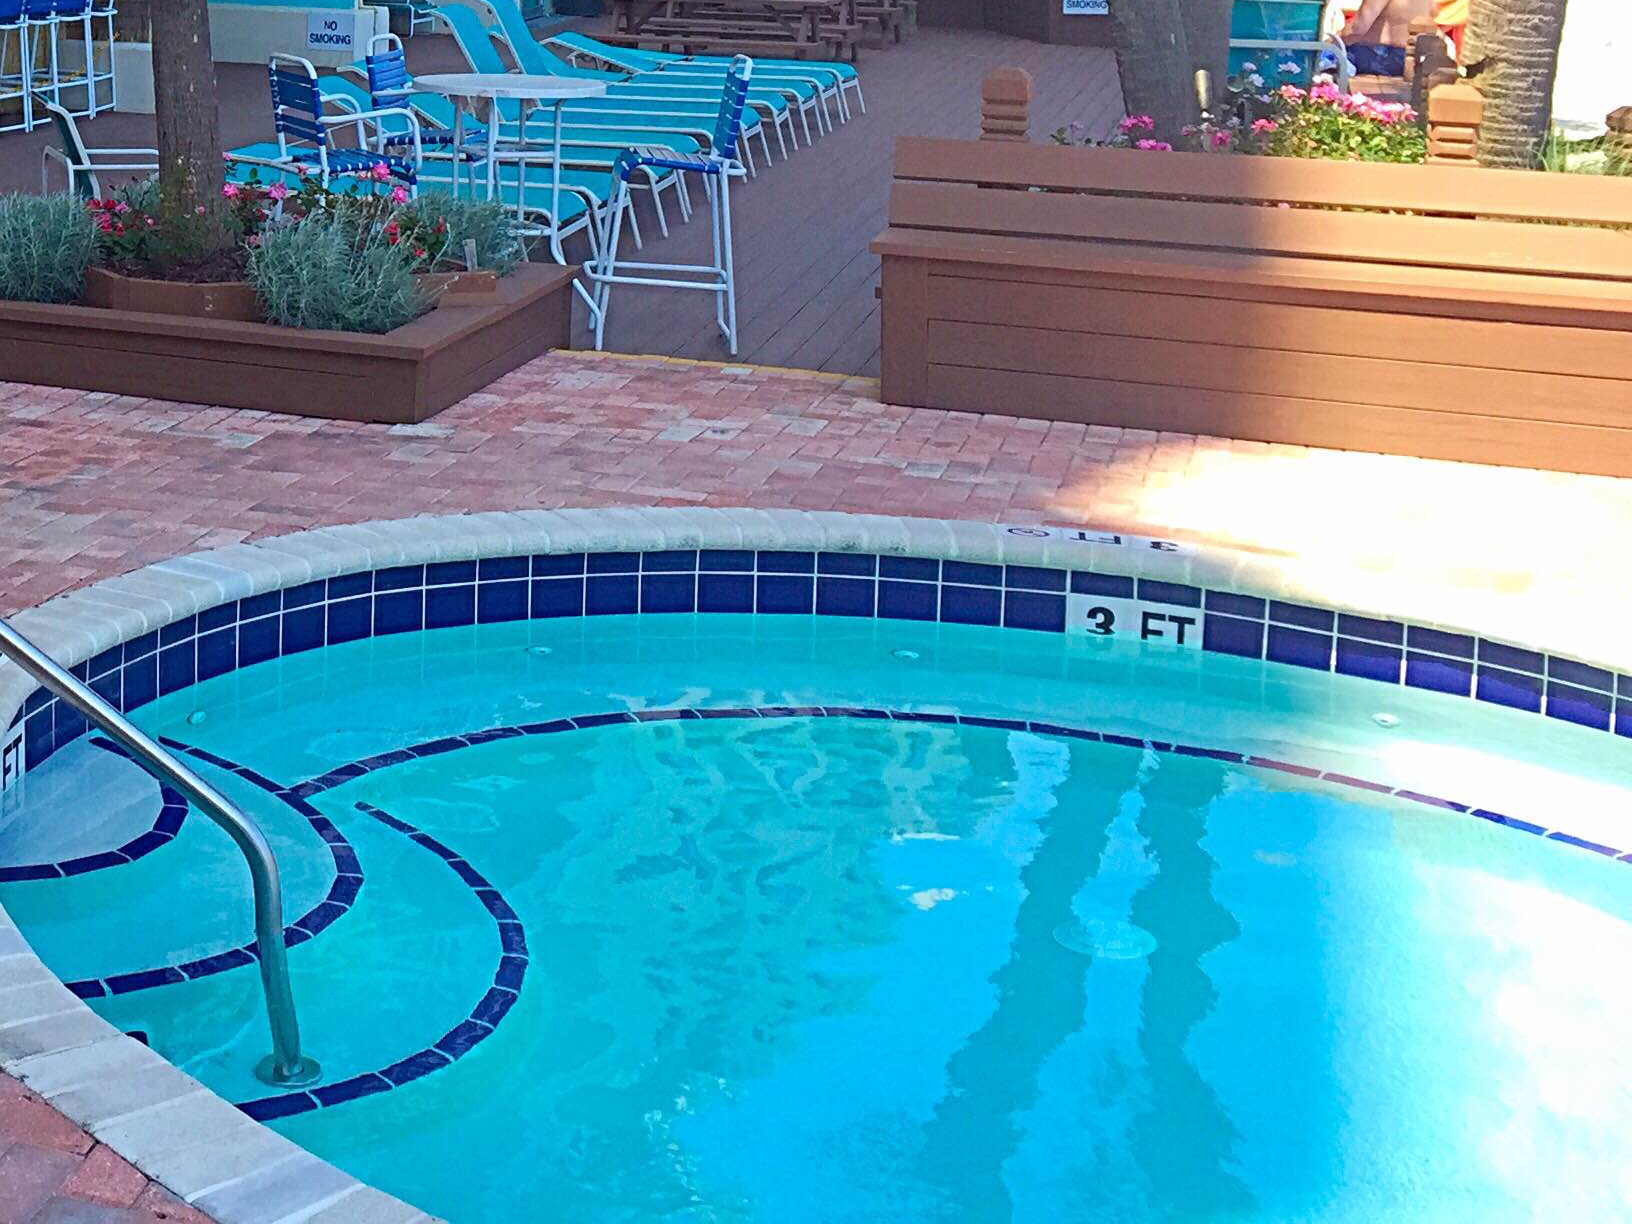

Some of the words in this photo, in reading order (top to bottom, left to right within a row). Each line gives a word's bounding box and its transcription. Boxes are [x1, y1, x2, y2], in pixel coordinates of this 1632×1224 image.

[1066, 0, 1107, 9] SMOKING
[324, 20, 338, 32] NO
[309, 33, 352, 45] SMOKING
[1086, 606, 1116, 636] 3
[1140, 610, 1197, 646] FT
[2, 732, 23, 792] FT
